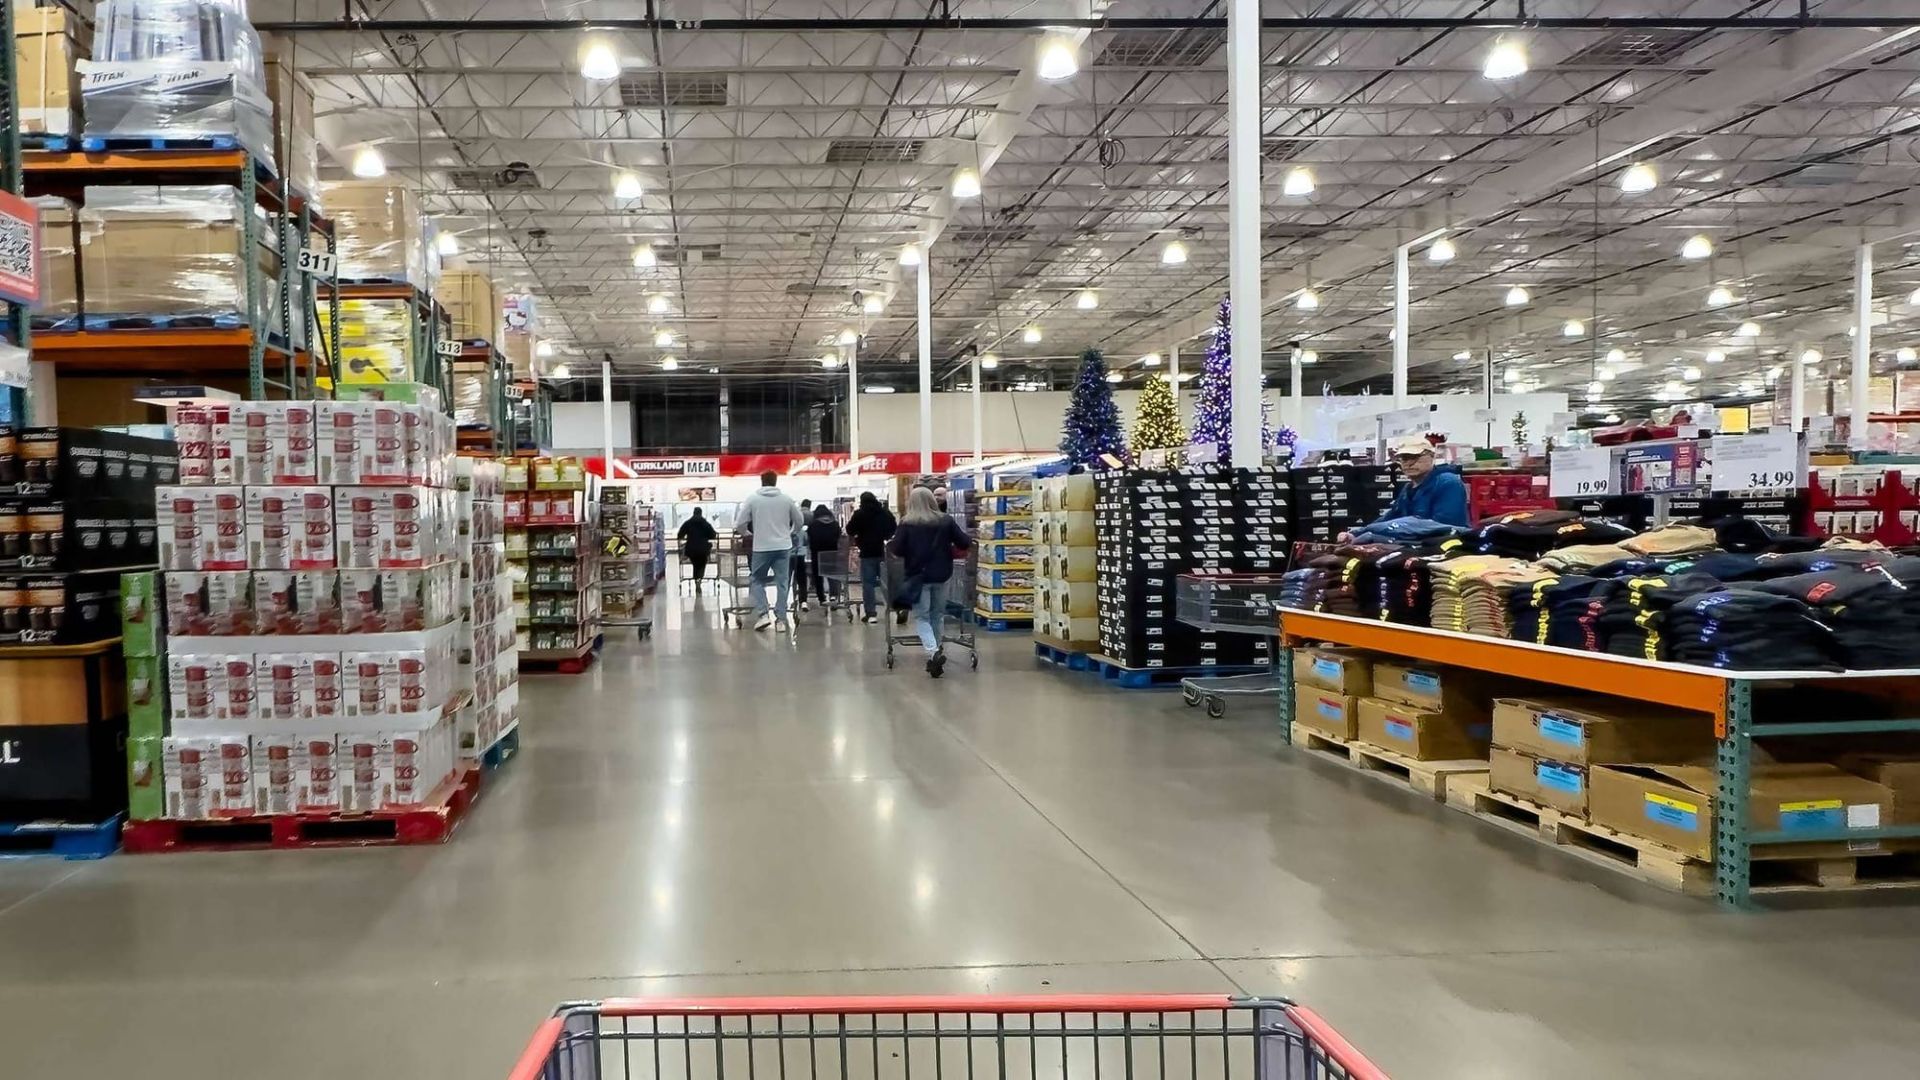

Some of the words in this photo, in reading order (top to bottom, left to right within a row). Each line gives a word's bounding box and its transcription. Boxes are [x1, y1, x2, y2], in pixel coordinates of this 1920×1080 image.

[299, 252, 330, 272] 311
[439, 342, 460, 354] 313
[505, 387, 524, 397] 315
[633, 461, 683, 471] KIRKLAND
[687, 462, 717, 473] MEAT
[1748, 471, 1795, 489] 34.99
[15, 482, 32, 495] 12
[1576, 480, 1608, 494] 19.99
[18, 555, 36, 568] 12
[19, 629, 37, 643] 12
